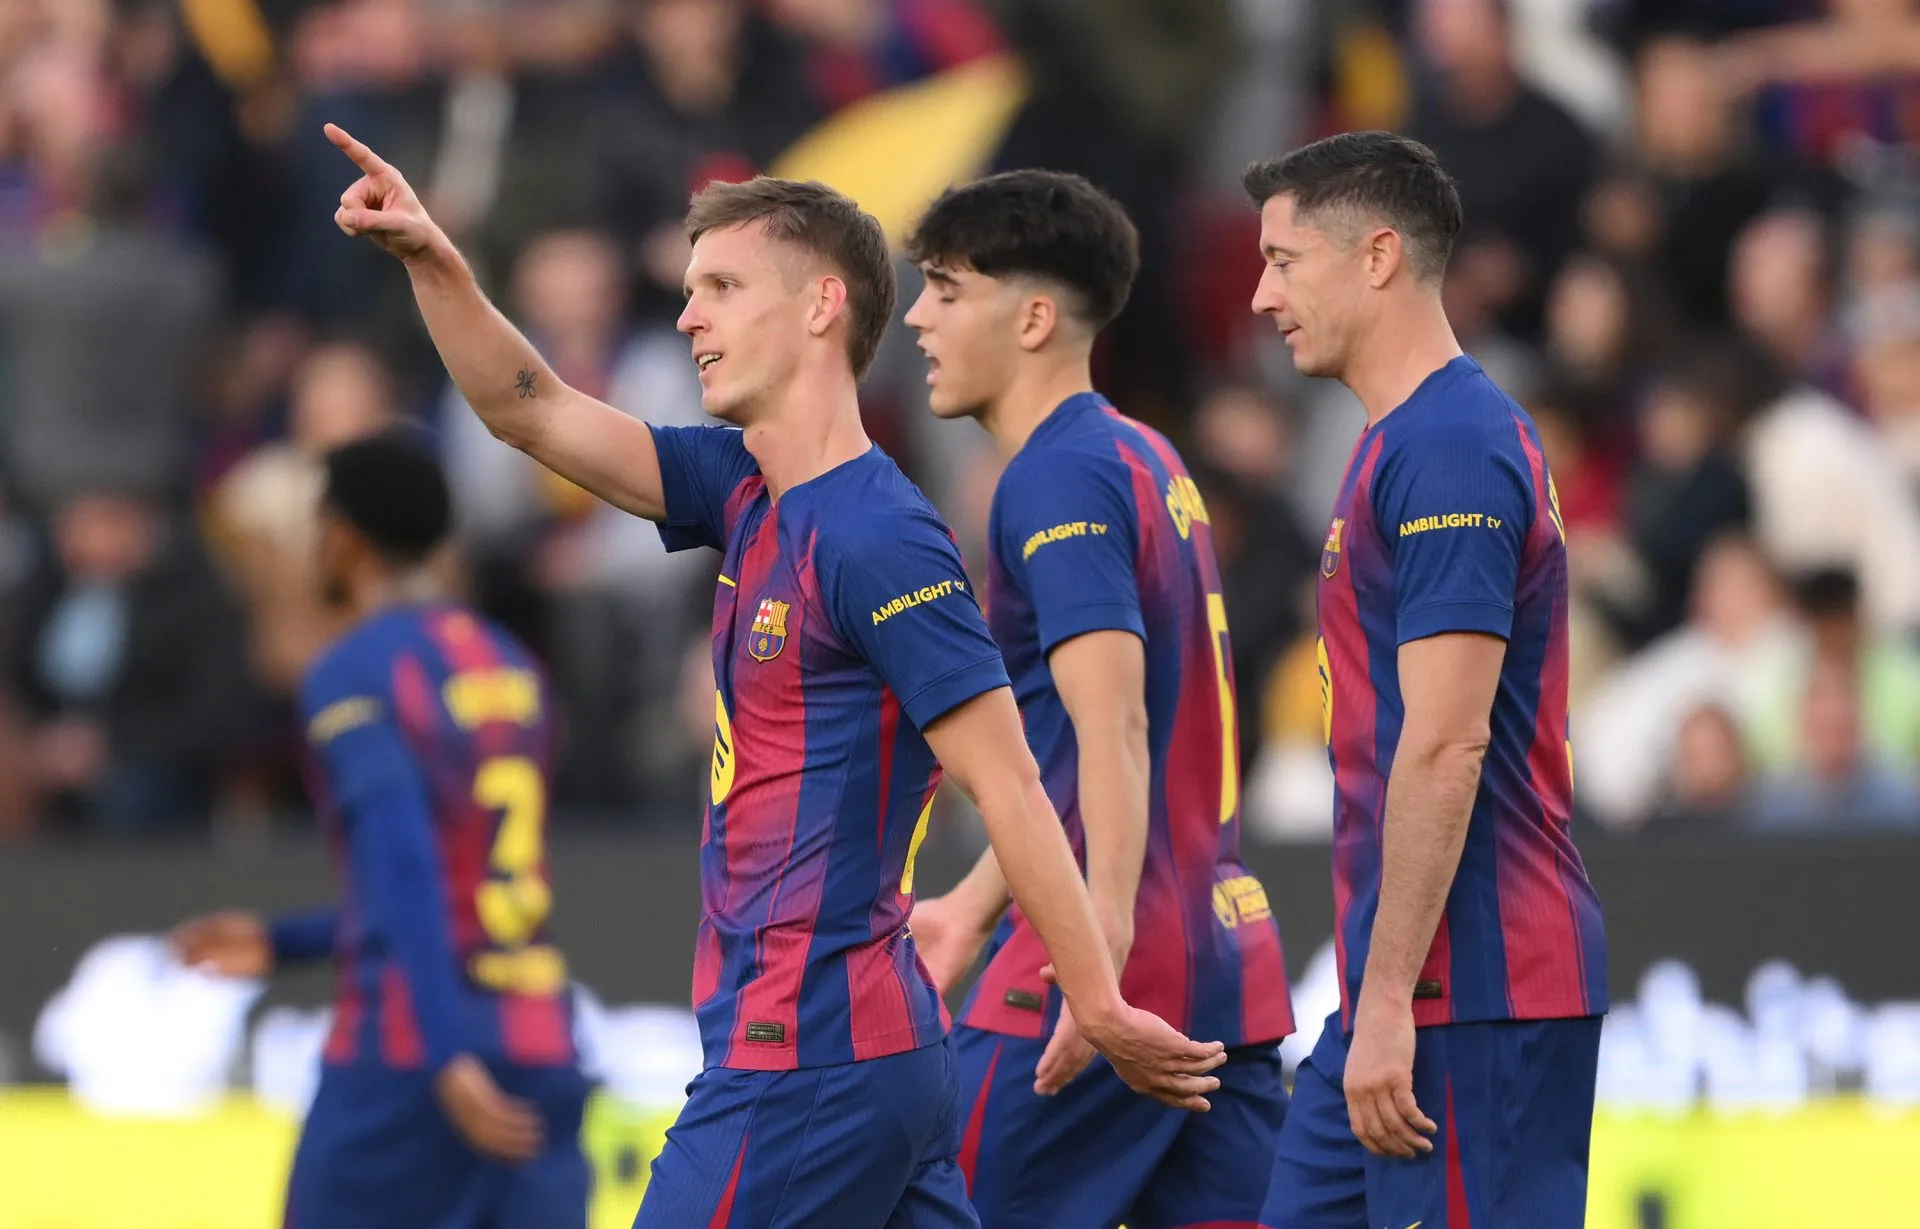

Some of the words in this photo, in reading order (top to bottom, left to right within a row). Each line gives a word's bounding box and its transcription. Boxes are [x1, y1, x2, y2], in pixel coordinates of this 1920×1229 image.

[1089, 522, 1107, 536] tv
[1400, 513, 1483, 537] AMBILIGHT
[1486, 516, 1501, 529] tv
[872, 581, 951, 625] AMBILIGHT
[473, 755, 551, 944] 3
